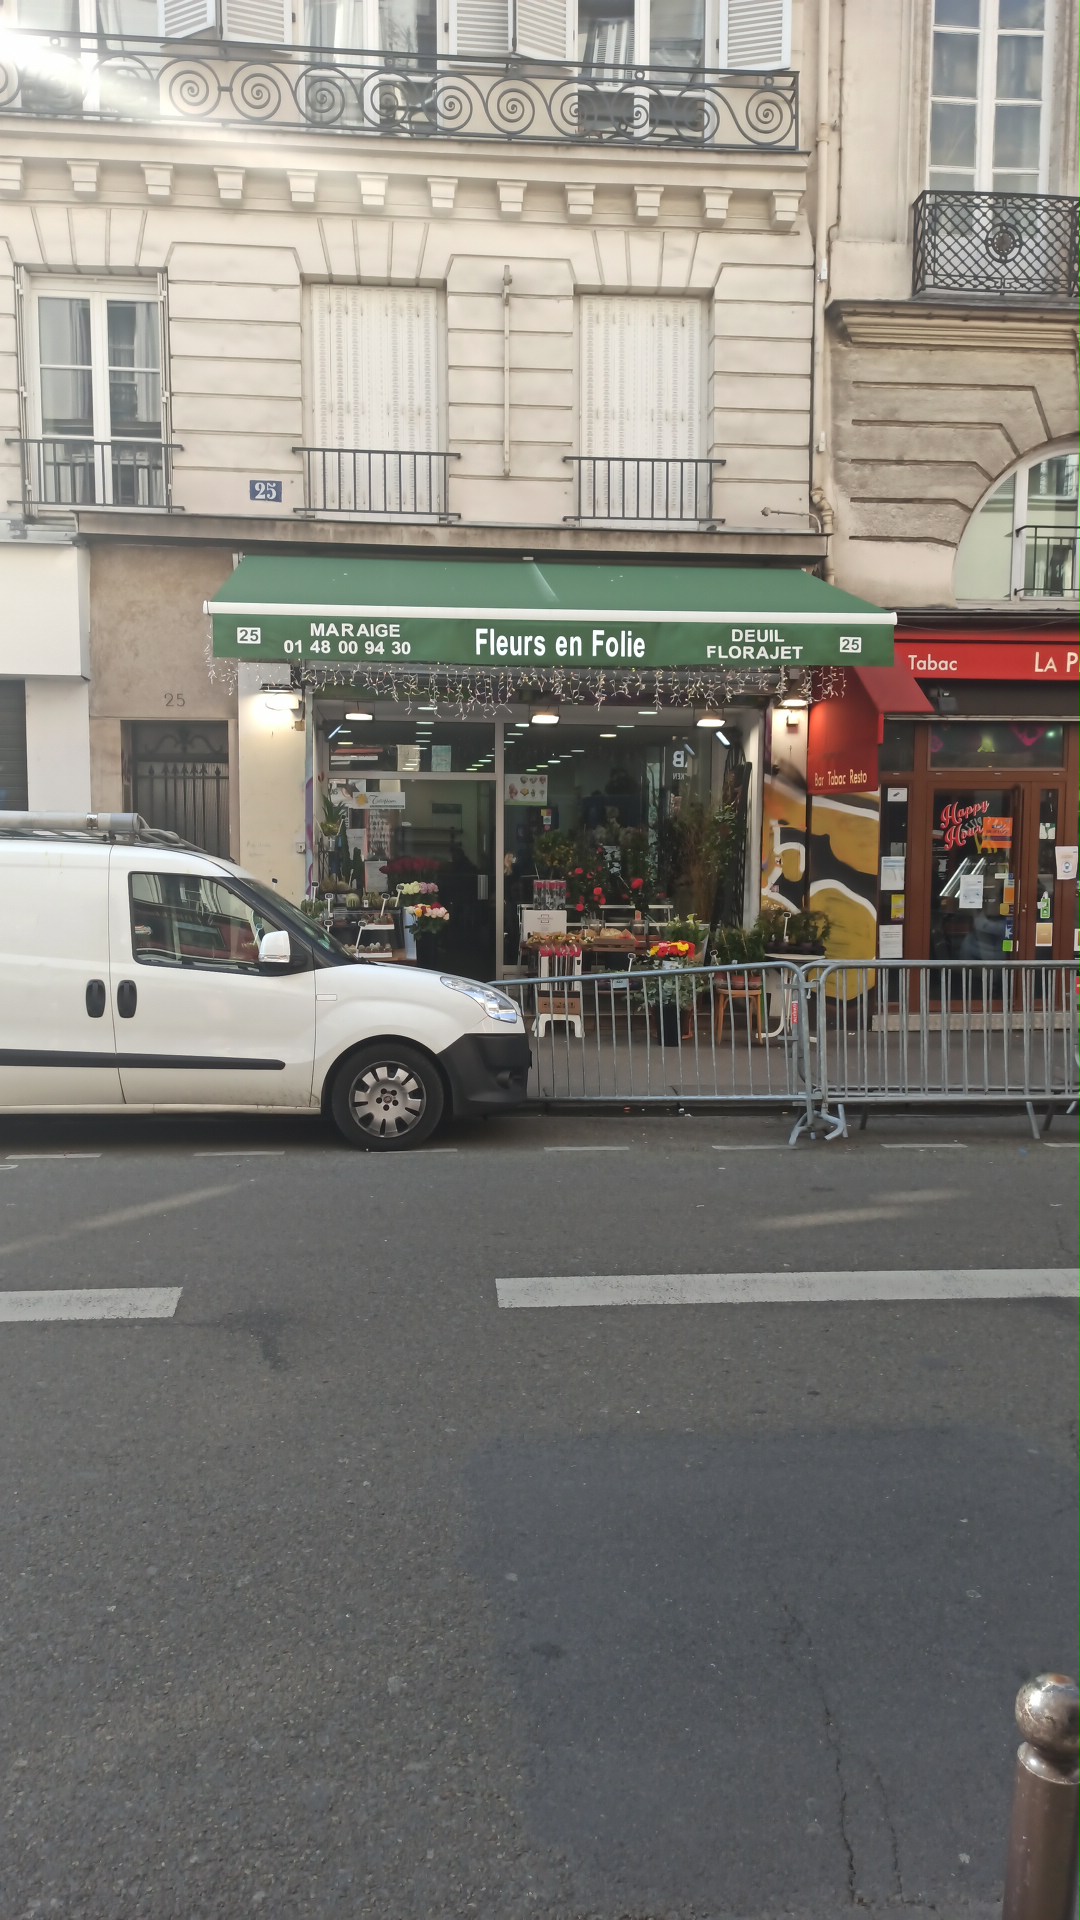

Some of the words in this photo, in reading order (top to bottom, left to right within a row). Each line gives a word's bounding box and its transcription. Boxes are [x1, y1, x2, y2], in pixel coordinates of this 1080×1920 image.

[254, 482, 277, 501] 25
[239, 629, 259, 642] 25
[311, 622, 401, 638] MARAIGE
[731, 628, 785, 643] DEUIL
[284, 639, 302, 653] 01
[310, 639, 331, 654] 48
[339, 640, 358, 654] 00
[365, 640, 385, 655] 94
[391, 641, 411, 655] 30
[475, 628, 546, 657] Fleurs
[555, 635, 582, 657] en
[593, 629, 646, 658] Folie
[841, 638, 860, 651] 25
[706, 645, 804, 660] FLORAJET
[908, 653, 958, 671] Tabac
[1034, 651, 1058, 673] LA
[164, 693, 186, 707] 25
[814, 772, 825, 787] Bar
[827, 769, 847, 786] Tabac
[849, 768, 868, 784] Resto
[940, 800, 990, 829] Happy
[943, 823, 984, 851] Hour
